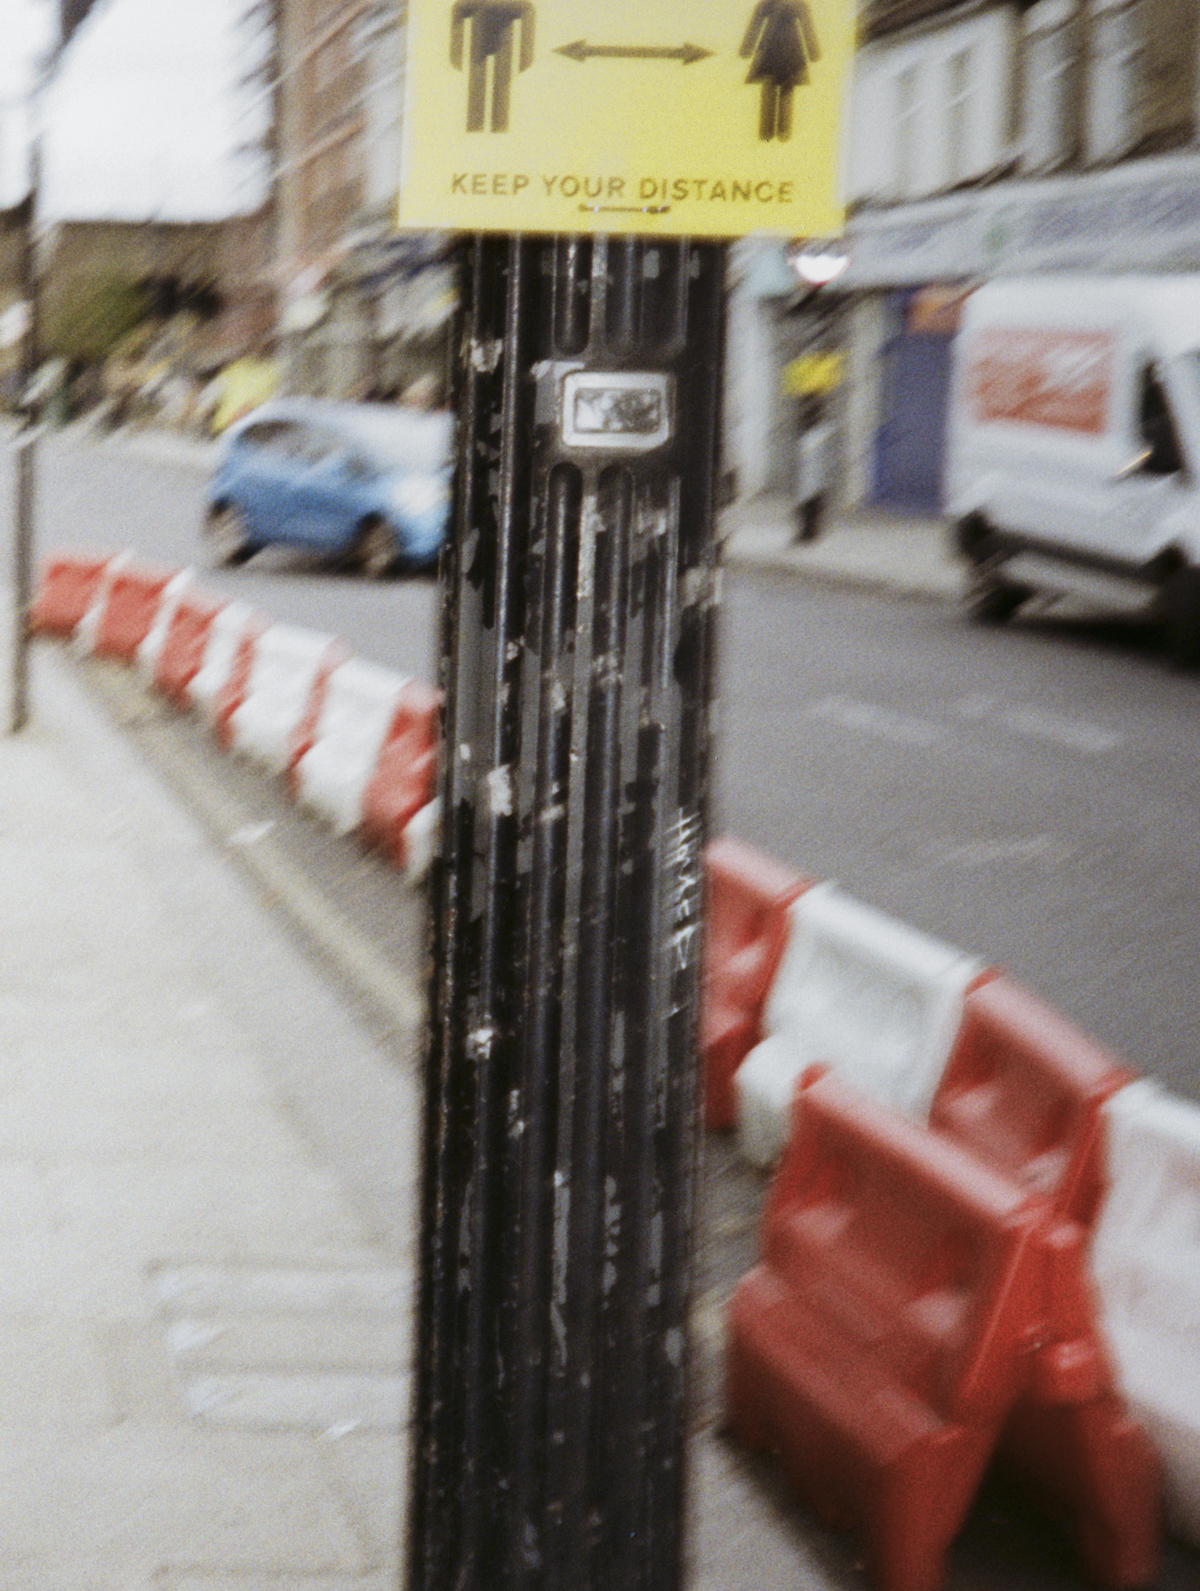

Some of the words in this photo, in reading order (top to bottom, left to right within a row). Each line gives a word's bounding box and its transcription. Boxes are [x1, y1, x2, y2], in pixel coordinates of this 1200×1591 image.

[451, 172, 530, 196] KEEP
[542, 174, 626, 198] YOUR
[639, 177, 794, 203] DISTANCE
